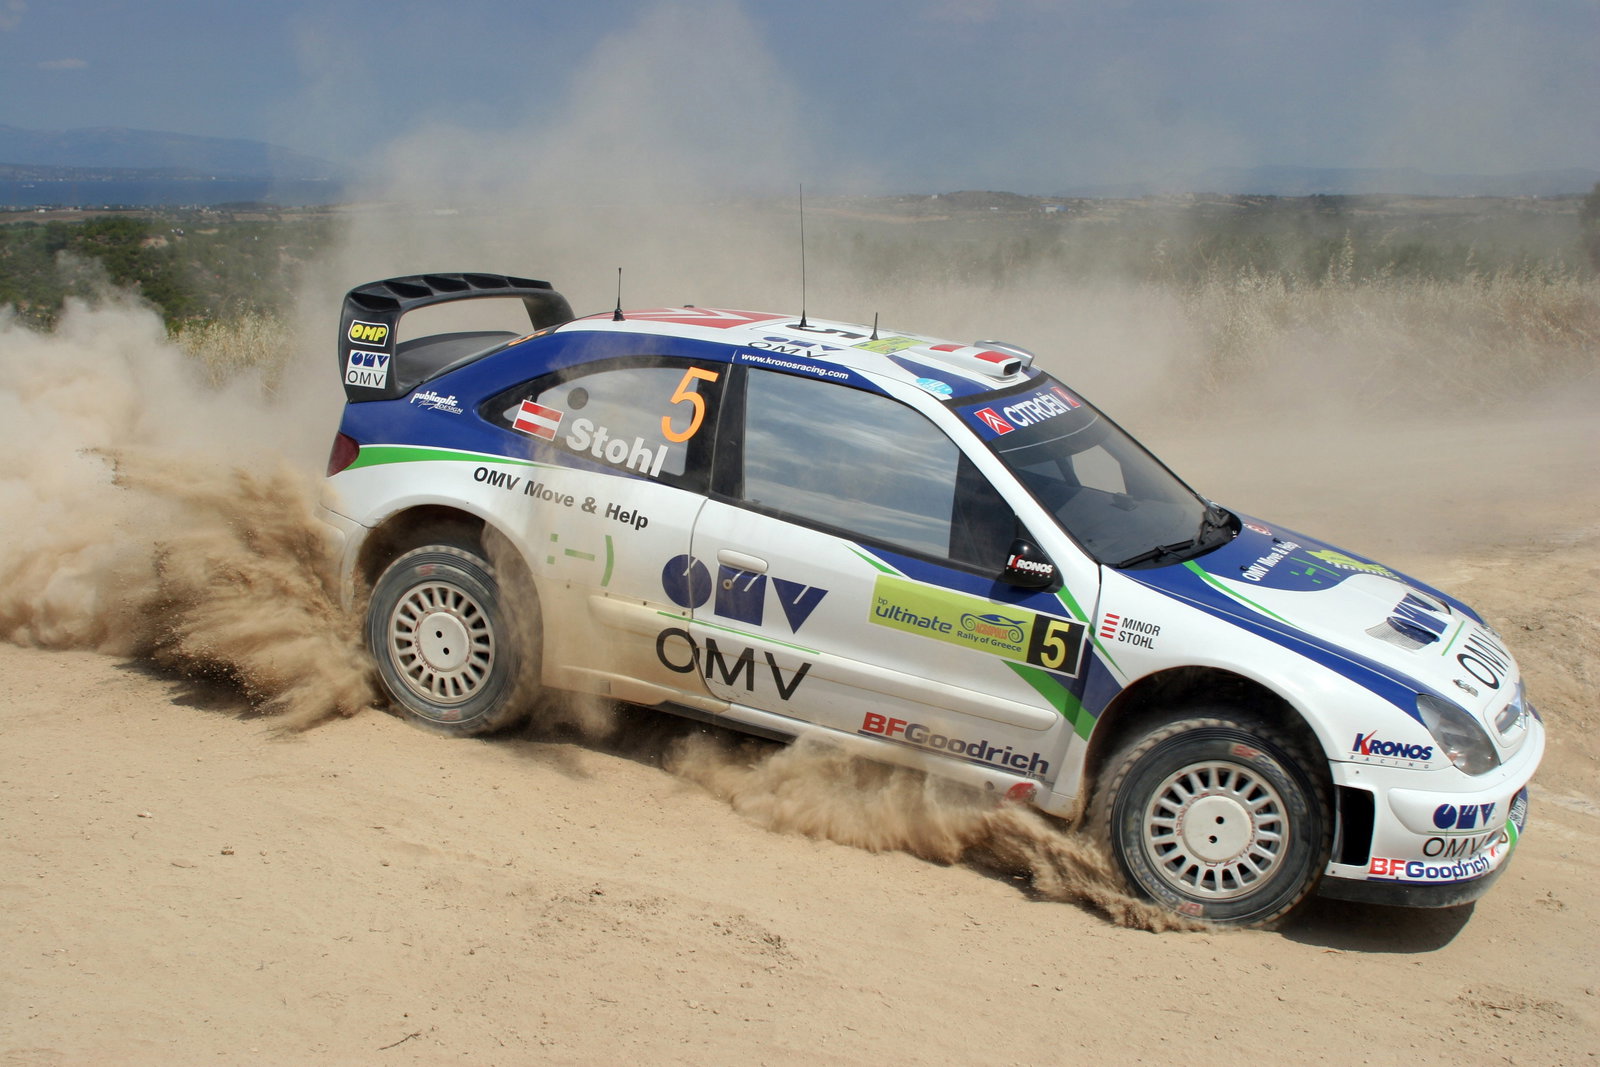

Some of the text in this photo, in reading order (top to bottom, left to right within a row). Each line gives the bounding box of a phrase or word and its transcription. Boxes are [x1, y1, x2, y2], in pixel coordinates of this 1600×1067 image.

[350, 324, 387, 341] OMP
[747, 341, 829, 358] OMV
[348, 370, 384, 386] OMV
[741, 353, 849, 380] www.kronosracing.com
[660, 366, 719, 443] 5
[1003, 391, 1071, 427] CITROËN
[565, 417, 668, 478] Stohl
[473, 466, 650, 531] OMV Move & Help
[1007, 554, 1053, 574] KRONOS
[878, 597, 889, 607] bp
[875, 602, 953, 635] ultimate
[1122, 617, 1161, 637] MINOR
[957, 630, 979, 642] Rally
[991, 639, 1022, 653] Greece
[1040, 620, 1070, 669] 5
[1117, 631, 1155, 650] STOHL
[656, 627, 813, 701] OMV
[1456, 627, 1512, 690] OMV
[861, 711, 1050, 775] BFGoodrich
[1353, 730, 1434, 761] KRONOS
[1369, 855, 1490, 879] BFGoodrich
